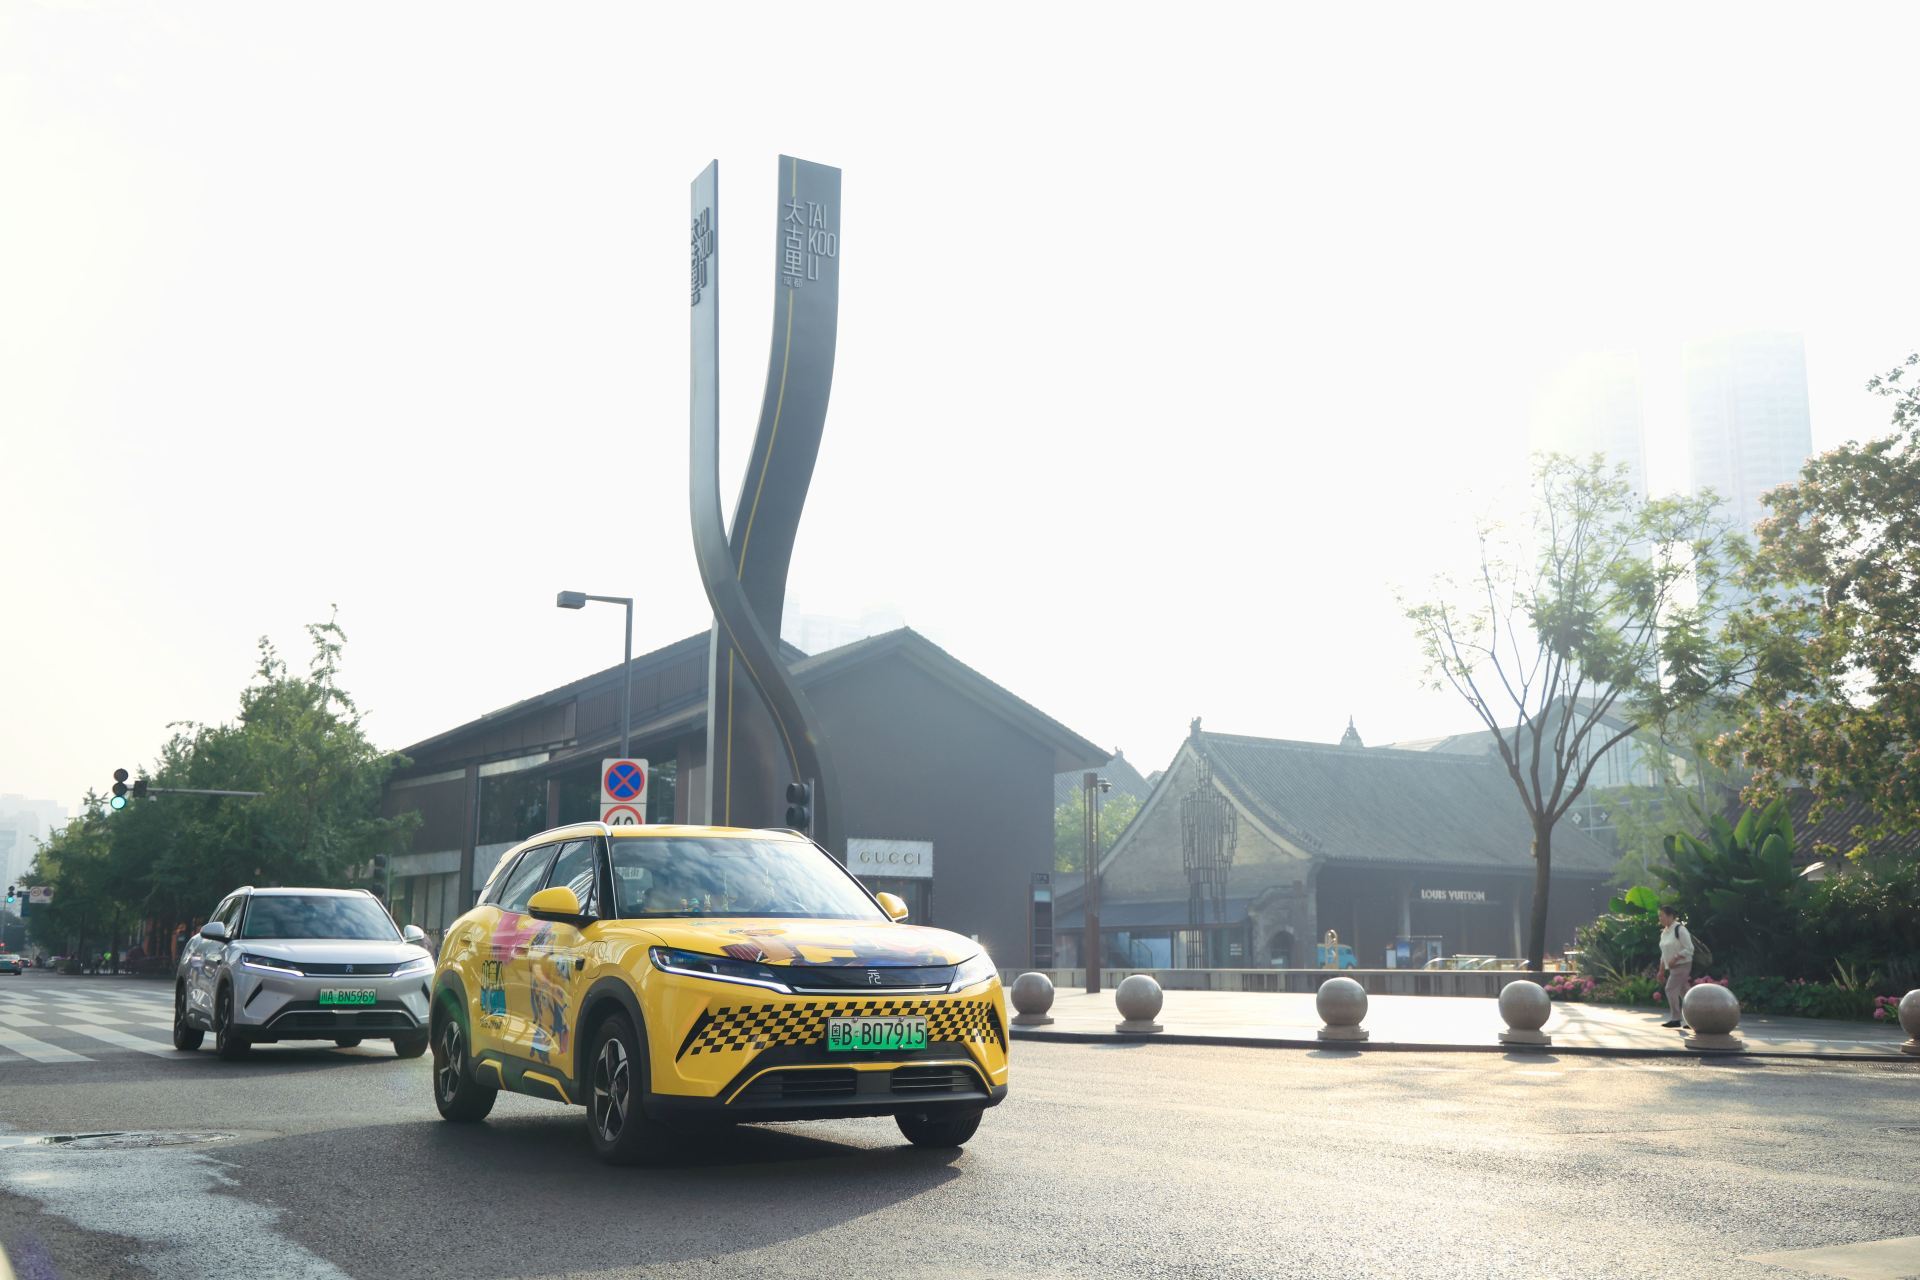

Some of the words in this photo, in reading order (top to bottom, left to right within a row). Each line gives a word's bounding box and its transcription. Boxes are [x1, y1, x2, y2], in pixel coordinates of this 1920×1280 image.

[805, 200, 827, 229] TAI
[783, 198, 804, 277] 太古里
[808, 228, 837, 257] KOO
[807, 253, 819, 281] LI
[860, 851, 920, 865] GUCCI
[1421, 889, 1446, 900] LOUIS
[1448, 890, 1485, 902] VUITTON
